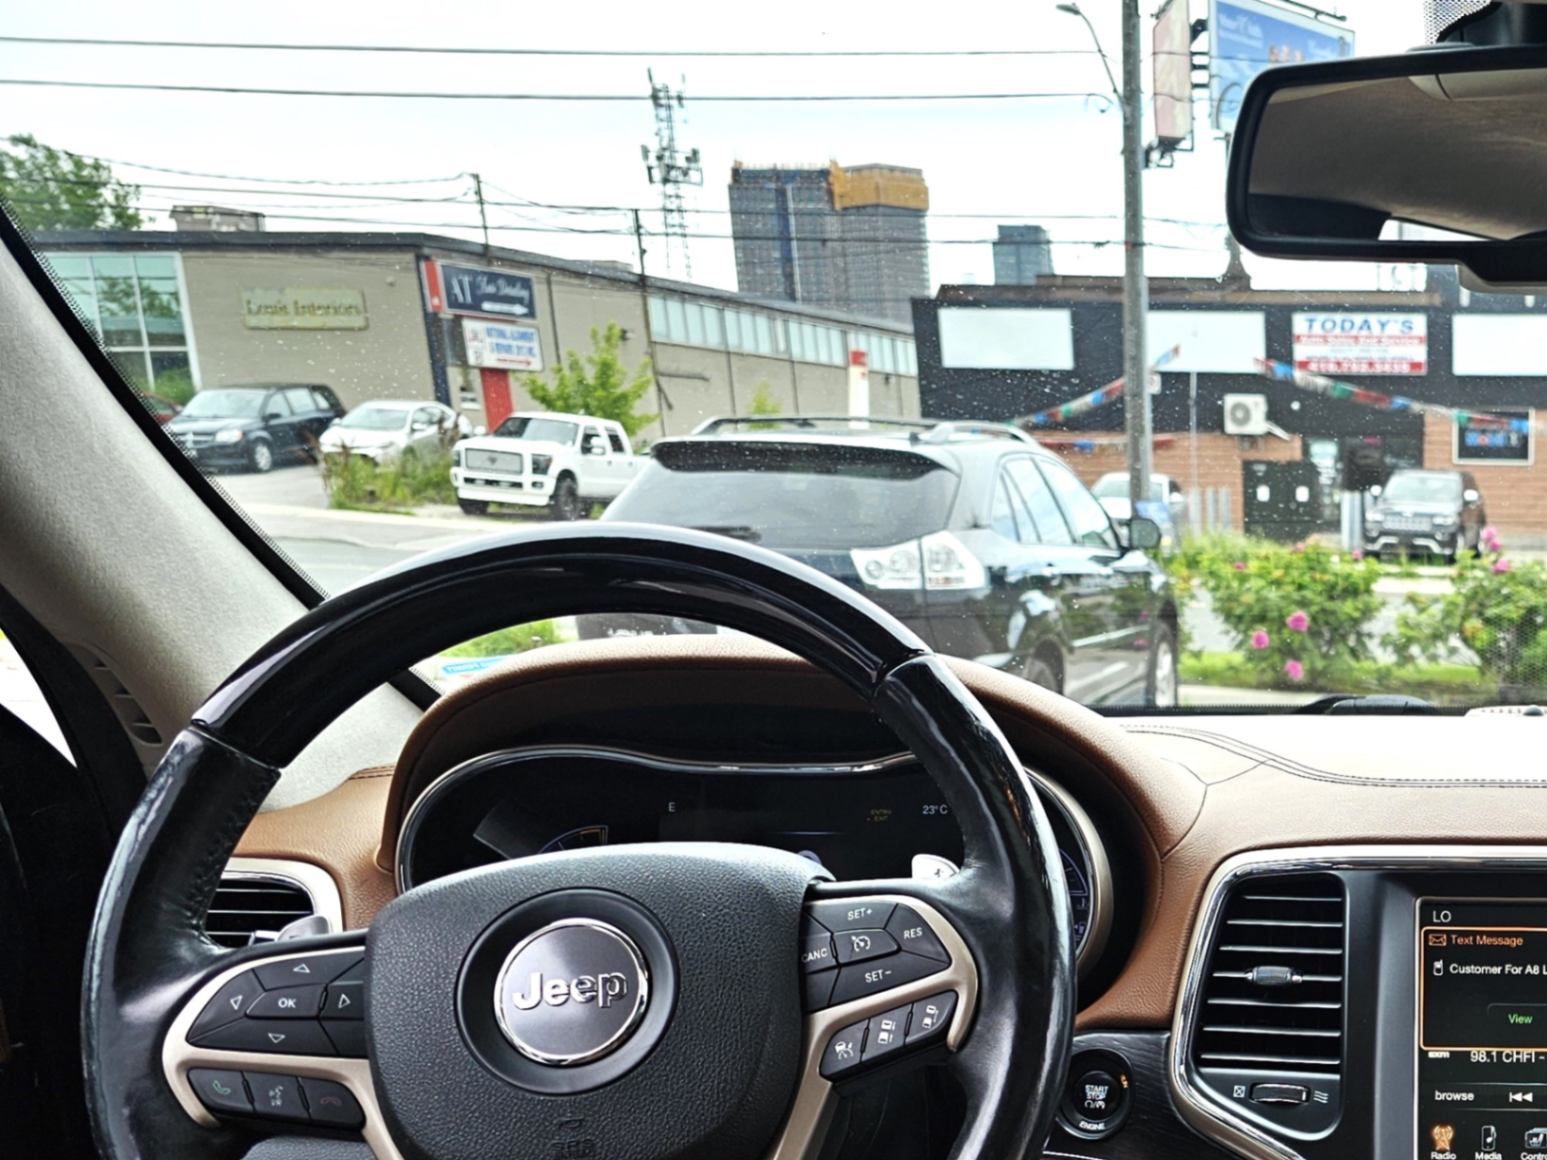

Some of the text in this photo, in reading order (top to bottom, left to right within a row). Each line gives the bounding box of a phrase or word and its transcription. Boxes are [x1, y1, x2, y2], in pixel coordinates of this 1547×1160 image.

[1304, 318, 1414, 332] TODAY'S
[1432, 910, 1452, 923] LO
[903, 927, 923, 940] RES
[1451, 935, 1524, 948] Text Message
[1450, 963, 1502, 975] Customer
[1505, 964, 1523, 975] For
[1525, 964, 1540, 975] A8
[511, 971, 628, 1010] Jeep
[278, 998, 296, 1009] OK
[1508, 1013, 1533, 1024] View
[1470, 1051, 1497, 1063] 98.1
[1502, 1051, 1535, 1063] CHFI
[1085, 1084, 1109, 1093] START
[1087, 1092, 1106, 1100] STOP
[1435, 1090, 1475, 1101] browse
[1079, 1121, 1105, 1130] ENGINE
[1431, 1152, 1457, 1160] Radio
[1475, 1152, 1502, 1160] Media
